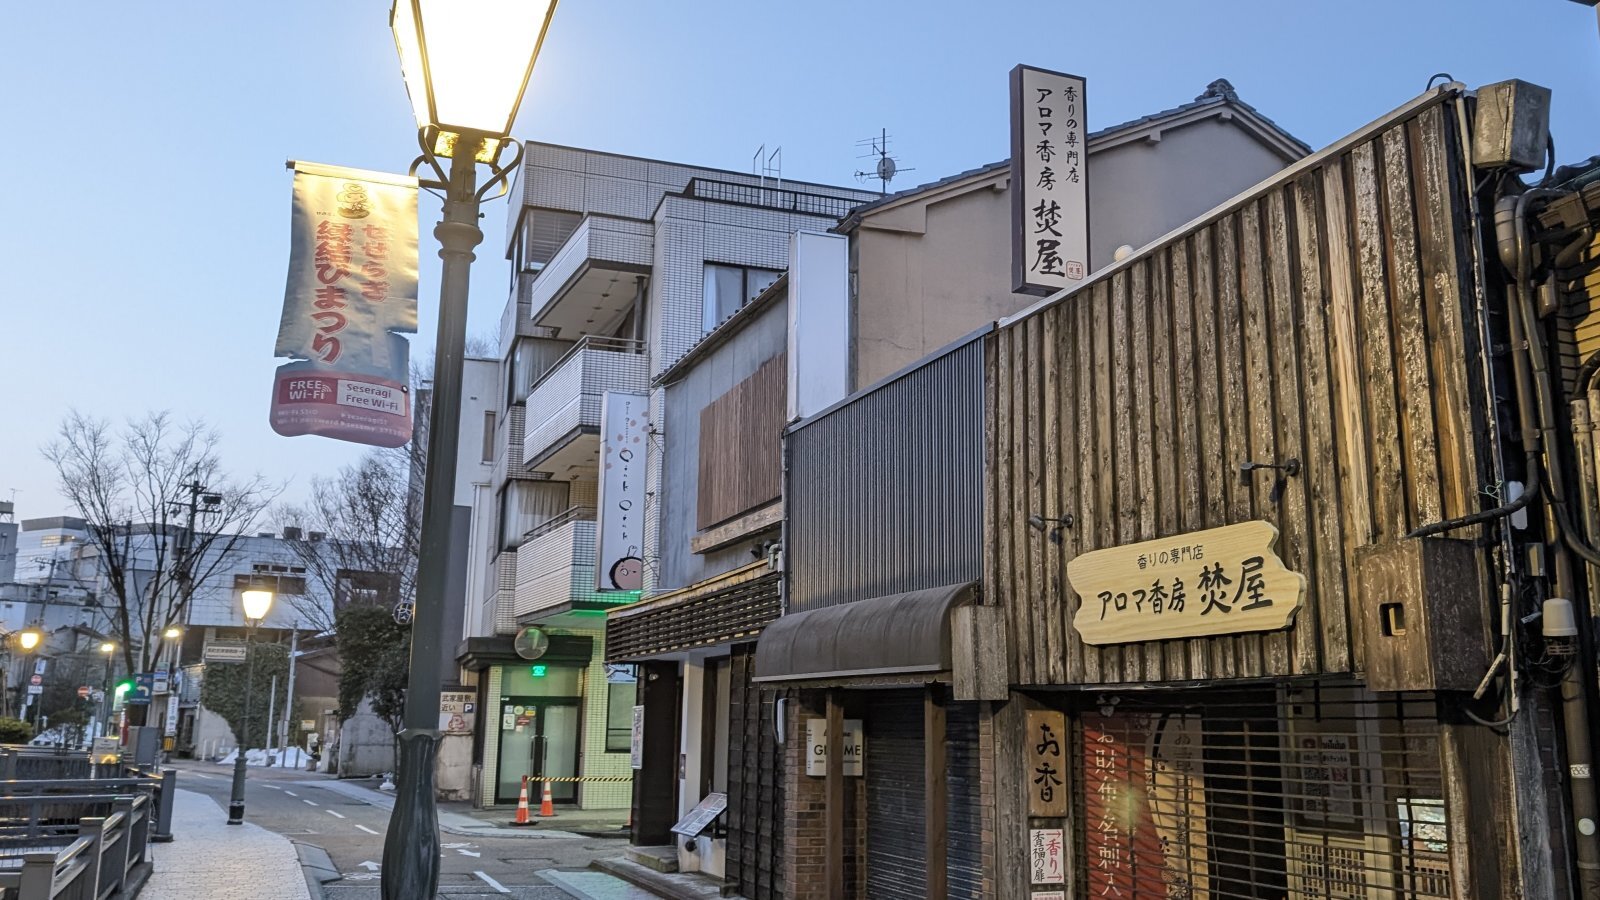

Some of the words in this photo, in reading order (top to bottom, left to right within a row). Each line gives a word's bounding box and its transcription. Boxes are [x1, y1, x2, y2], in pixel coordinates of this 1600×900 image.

[1035, 88, 1056, 191] アロマ香房
[1063, 86, 1080, 184] 香りの専門店
[1030, 198, 1065, 278] 焚屋
[360, 223, 389, 303] せせらぎ
[289, 380, 323, 391] FREE
[289, 389, 325, 400] Wi-Fi
[345, 394, 369, 405] Free
[372, 398, 398, 411] Wi-Fi
[346, 383, 392, 399] Seseragi
[1137, 544, 1204, 570] 香りの専門店
[1097, 577, 1186, 621] アロマ香房
[1197, 555, 1273, 616] 焚屋
[464, 704, 473, 712] P
[1034, 723, 1063, 803] お香
[1045, 838, 1062, 875] 香り
